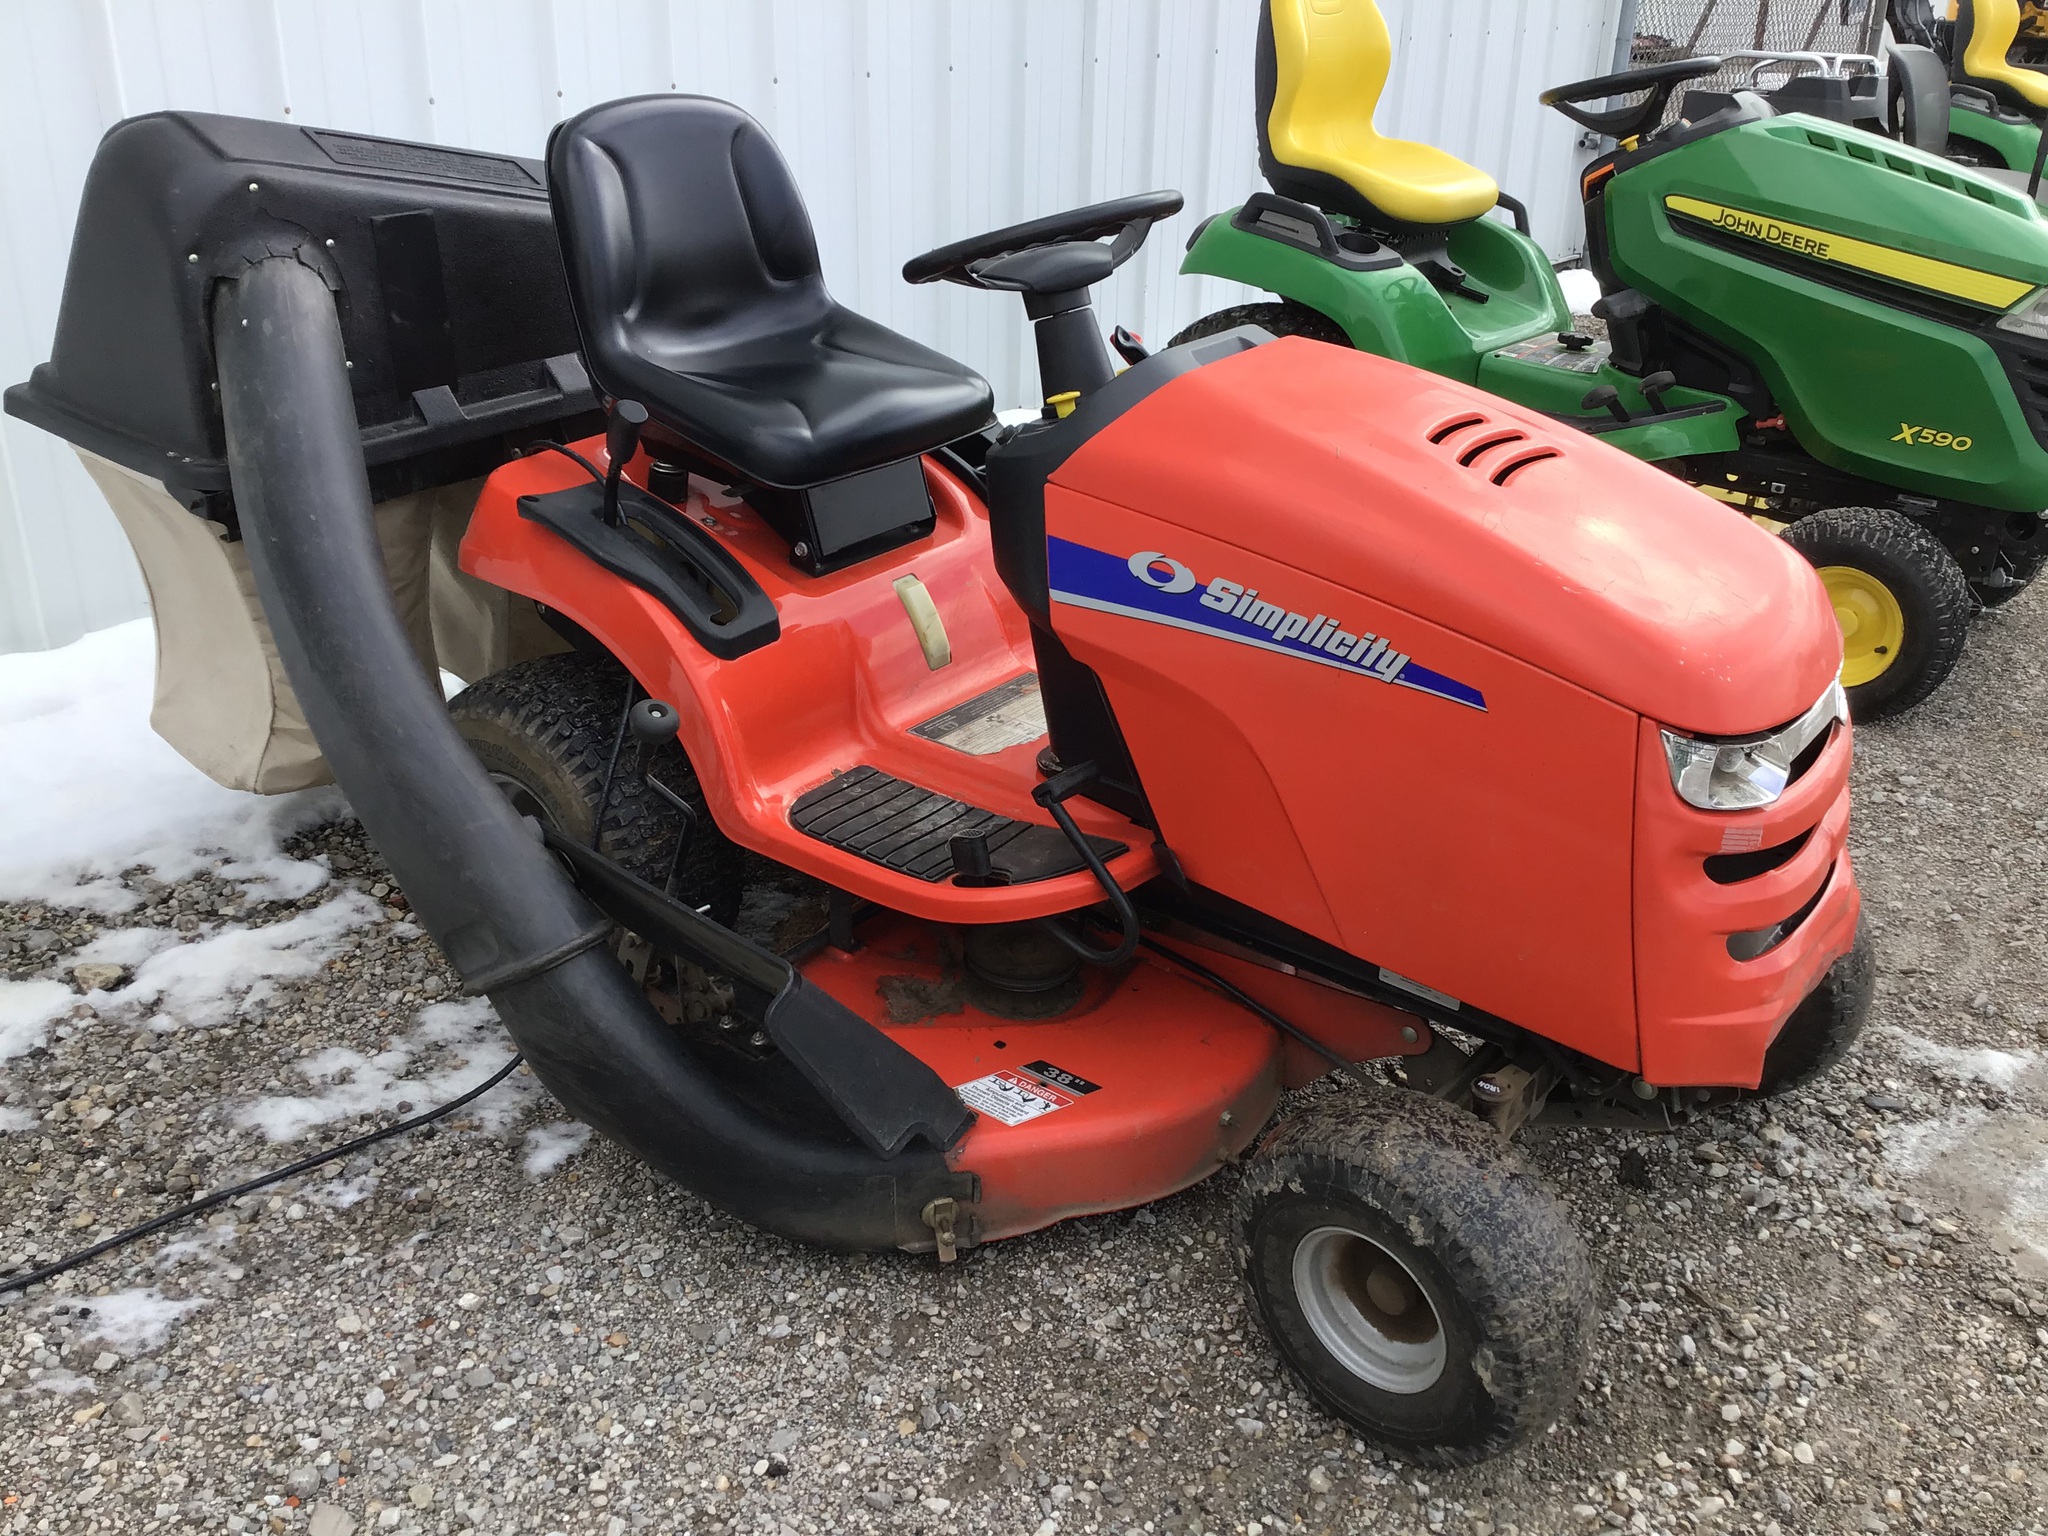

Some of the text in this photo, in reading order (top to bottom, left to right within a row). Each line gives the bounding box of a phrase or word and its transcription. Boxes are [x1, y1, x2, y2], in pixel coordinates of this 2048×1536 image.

[1712, 208, 1830, 258] JOHN DEERE
[1889, 422, 1973, 452] X590
[1199, 577, 1411, 684] Simplicity
[1018, 1080, 1058, 1102] DANGER
[1043, 1066, 1086, 1086] 38"
